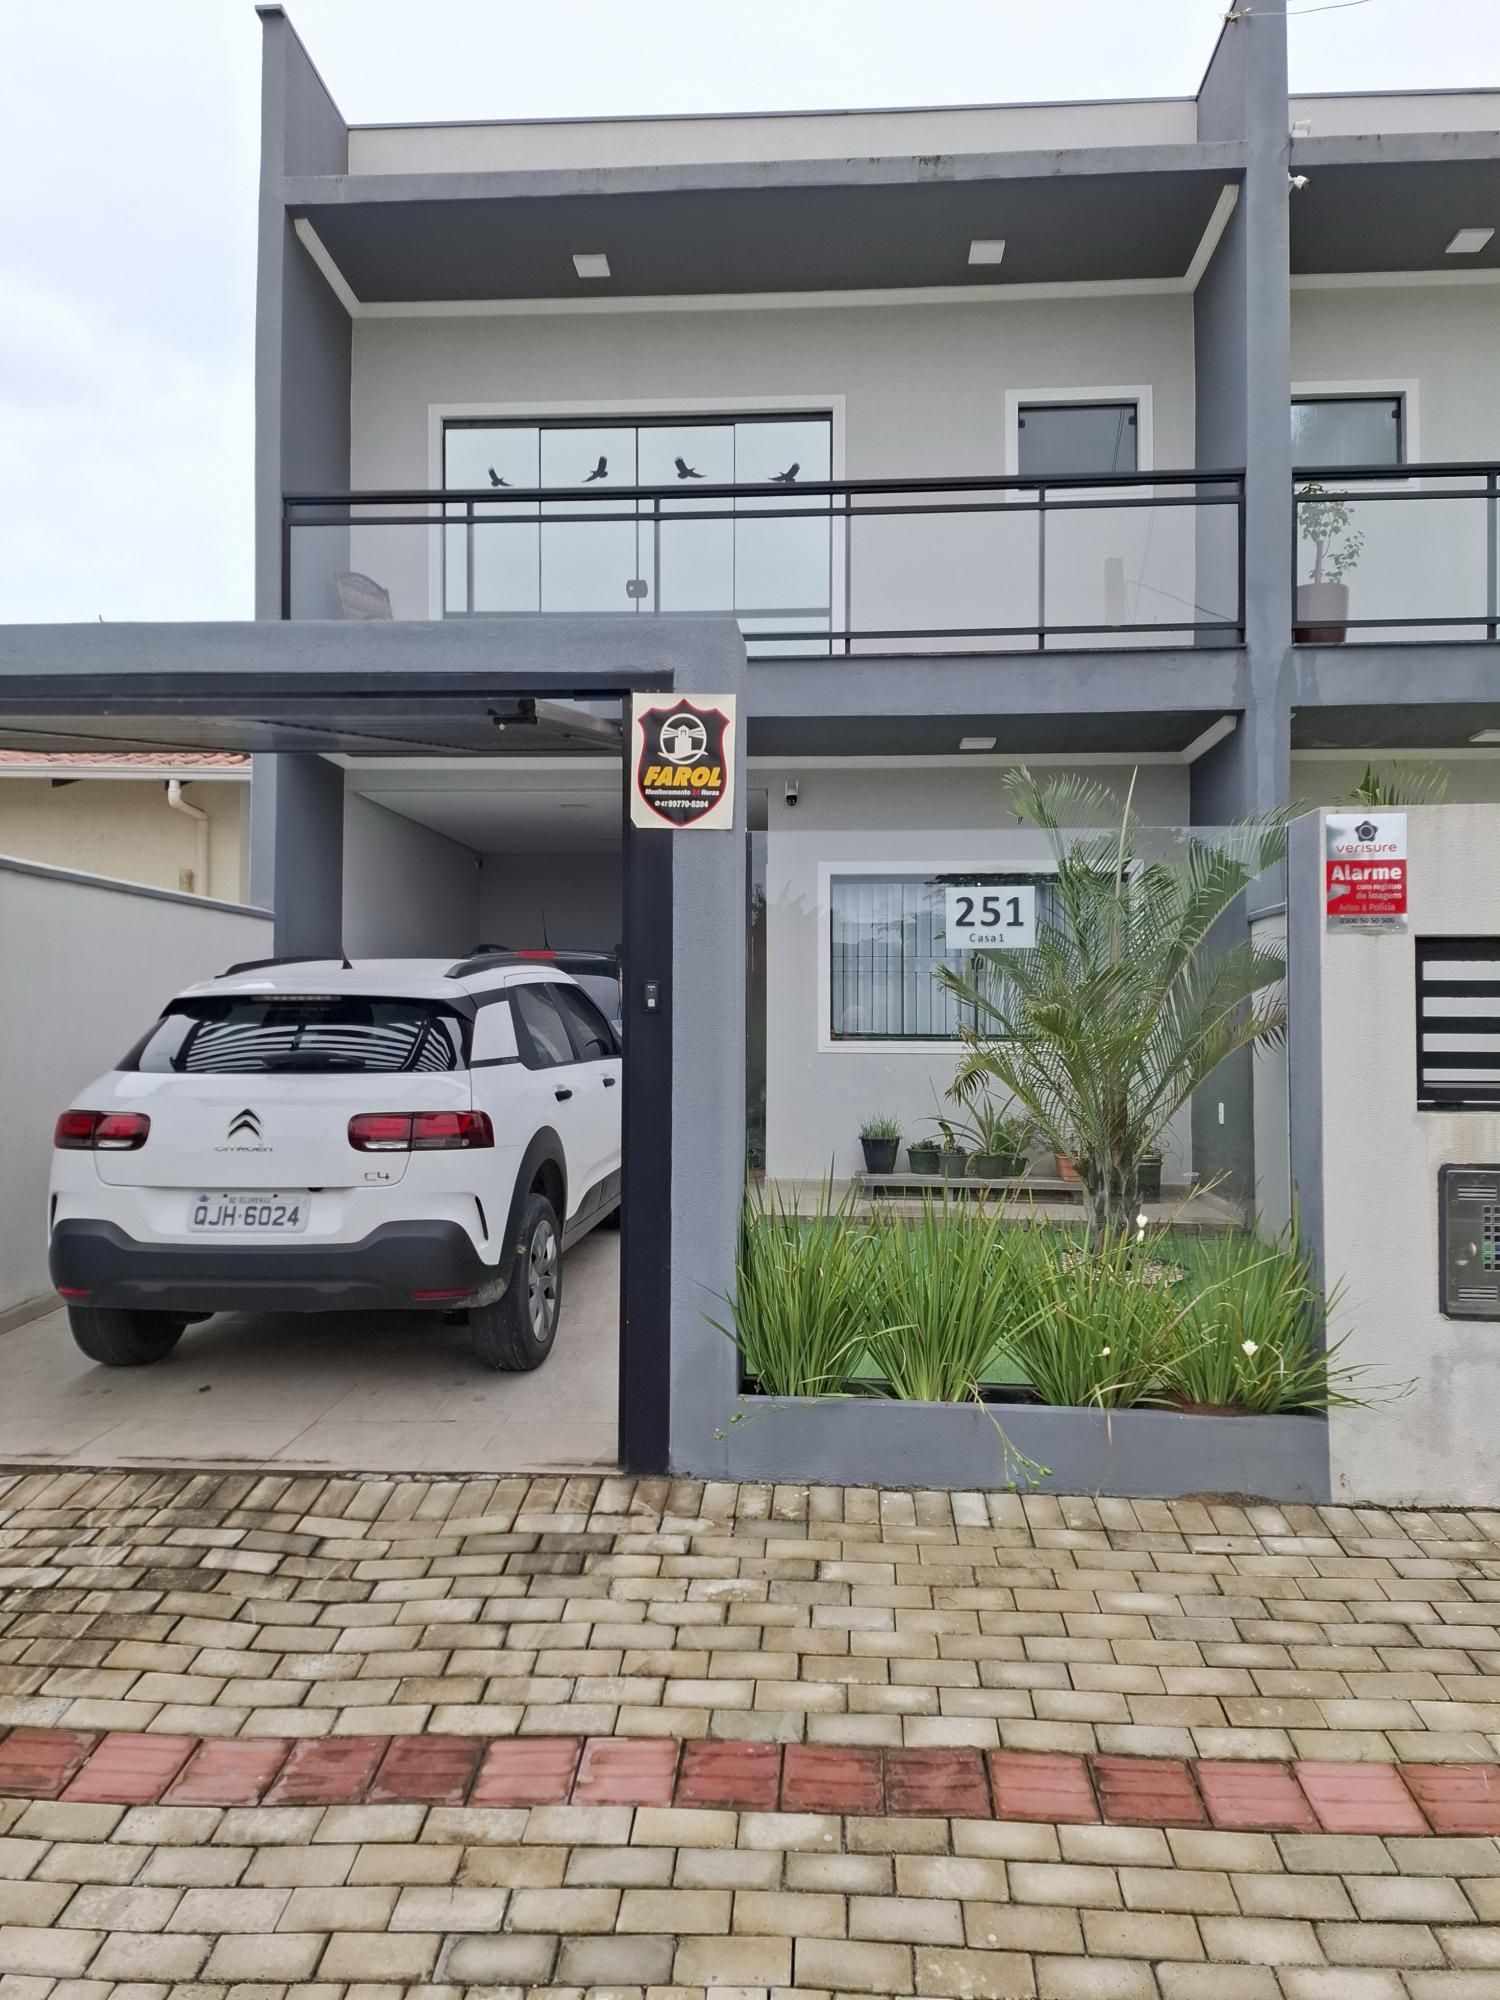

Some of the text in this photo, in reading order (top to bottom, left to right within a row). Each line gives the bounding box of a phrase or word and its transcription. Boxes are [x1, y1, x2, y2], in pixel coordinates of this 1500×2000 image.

[643, 766, 722, 787] FAROL
[1336, 843, 1398, 853] verisure
[1331, 864, 1402, 880] Alarme
[955, 896, 1024, 927] 251
[1339, 903, 1360, 911] Aviso
[364, 1171, 390, 1181] C4
